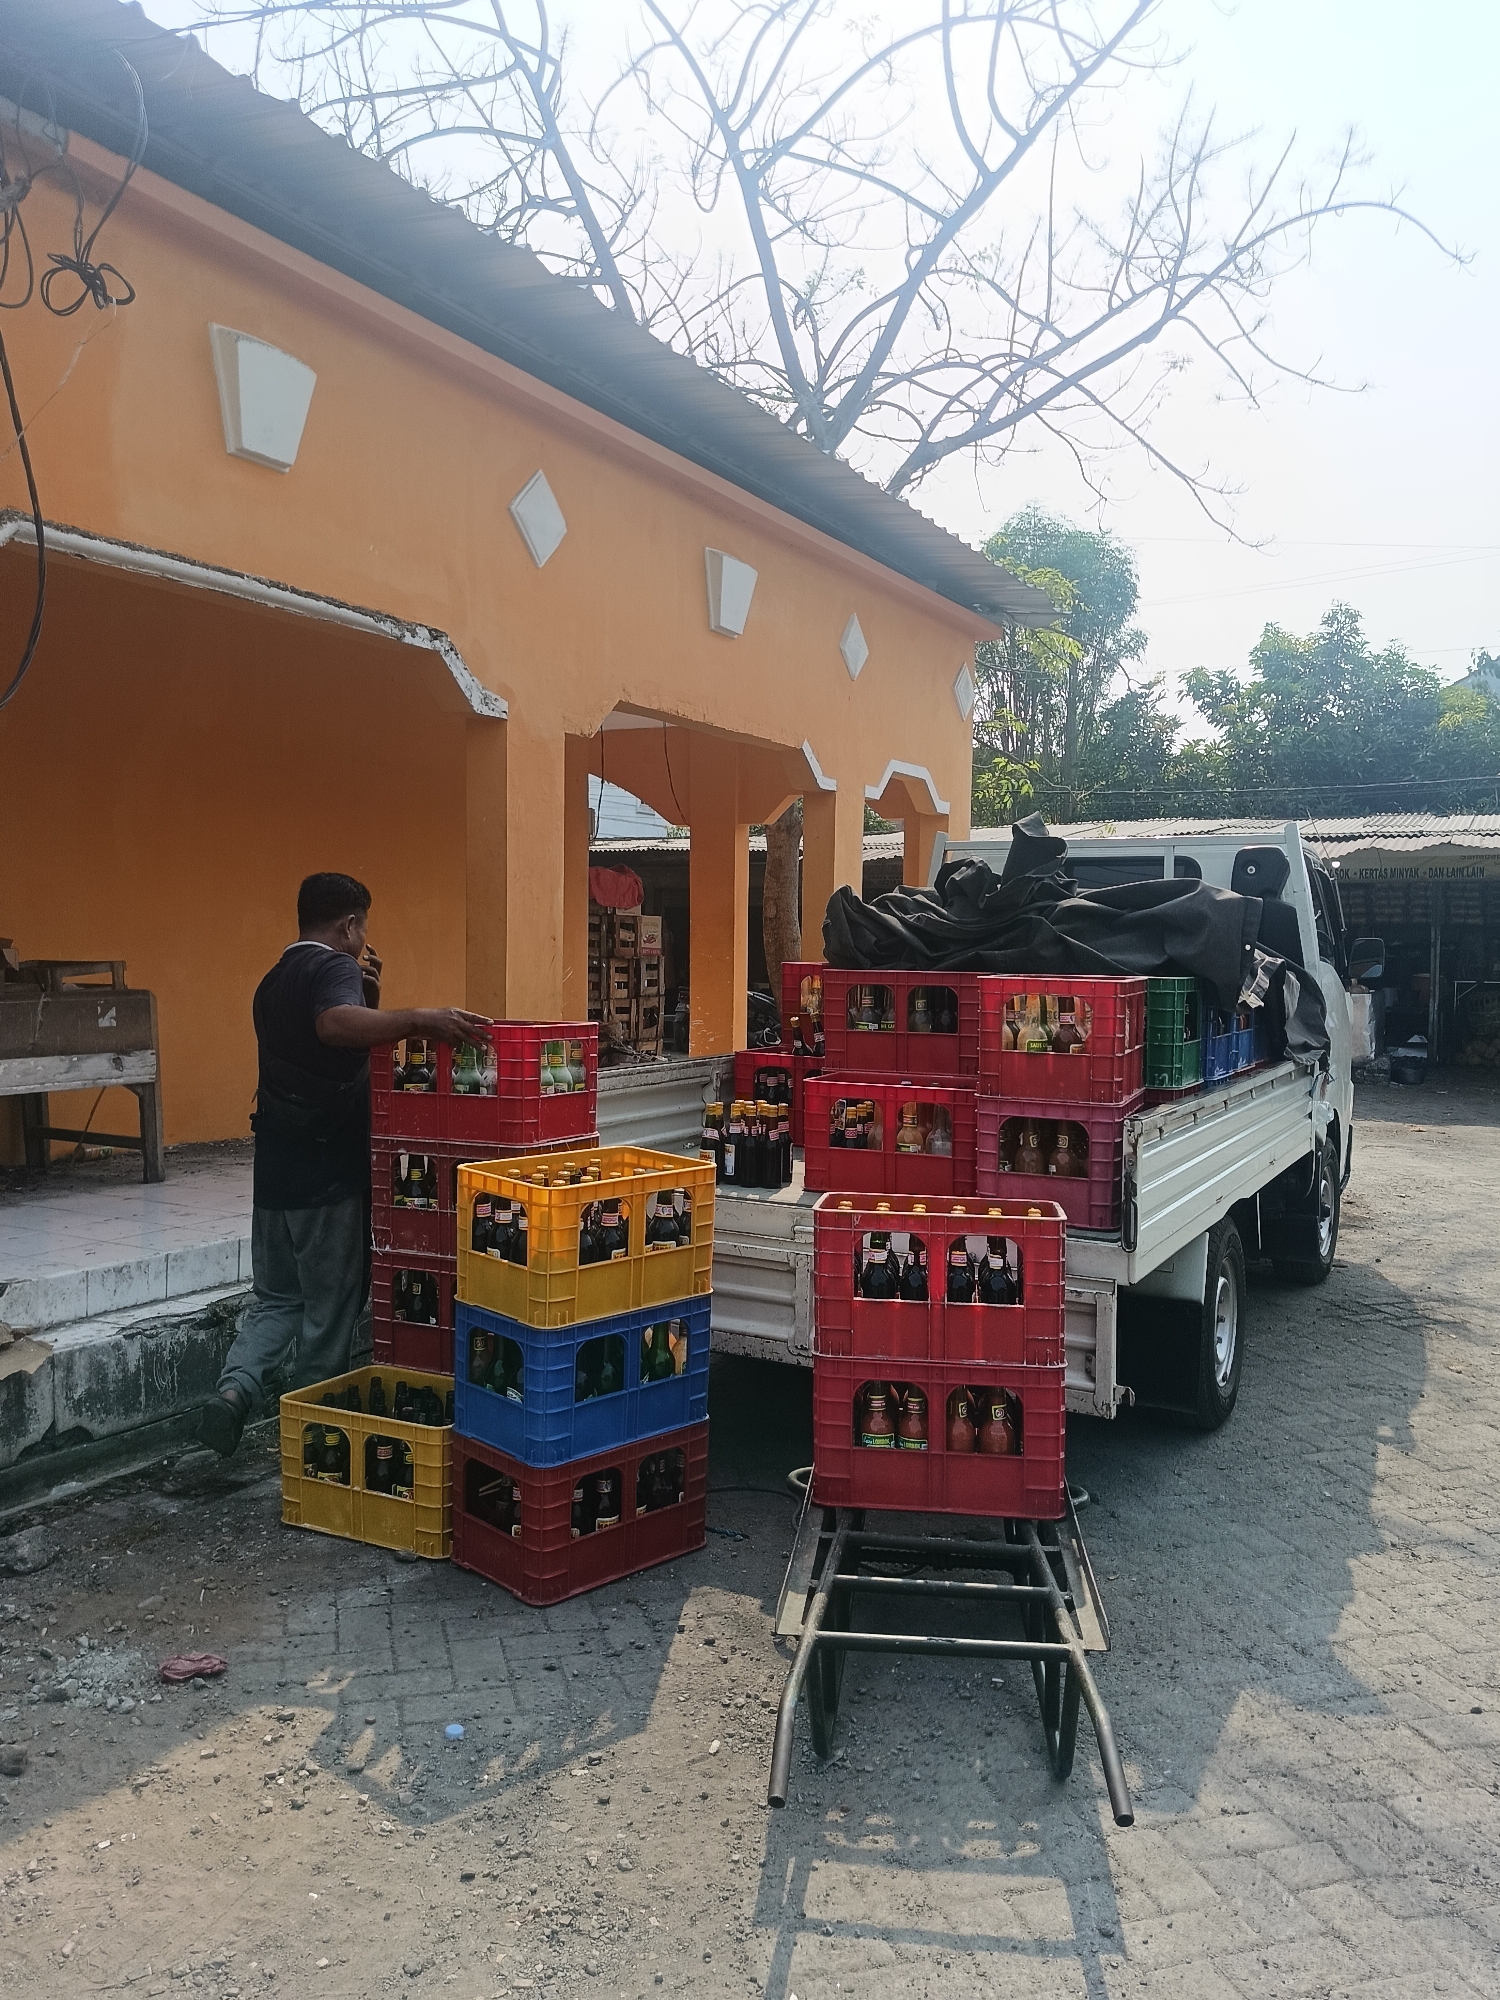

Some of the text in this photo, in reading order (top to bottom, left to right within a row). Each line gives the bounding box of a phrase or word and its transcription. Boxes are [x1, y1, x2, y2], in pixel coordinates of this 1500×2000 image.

[1359, 867, 1388, 879] KERTAS
[1389, 867, 1420, 879] MINYAK
[1428, 867, 1445, 879] DAN
[1446, 866, 1465, 879] LAIN
[1466, 866, 1485, 878] LAIN
